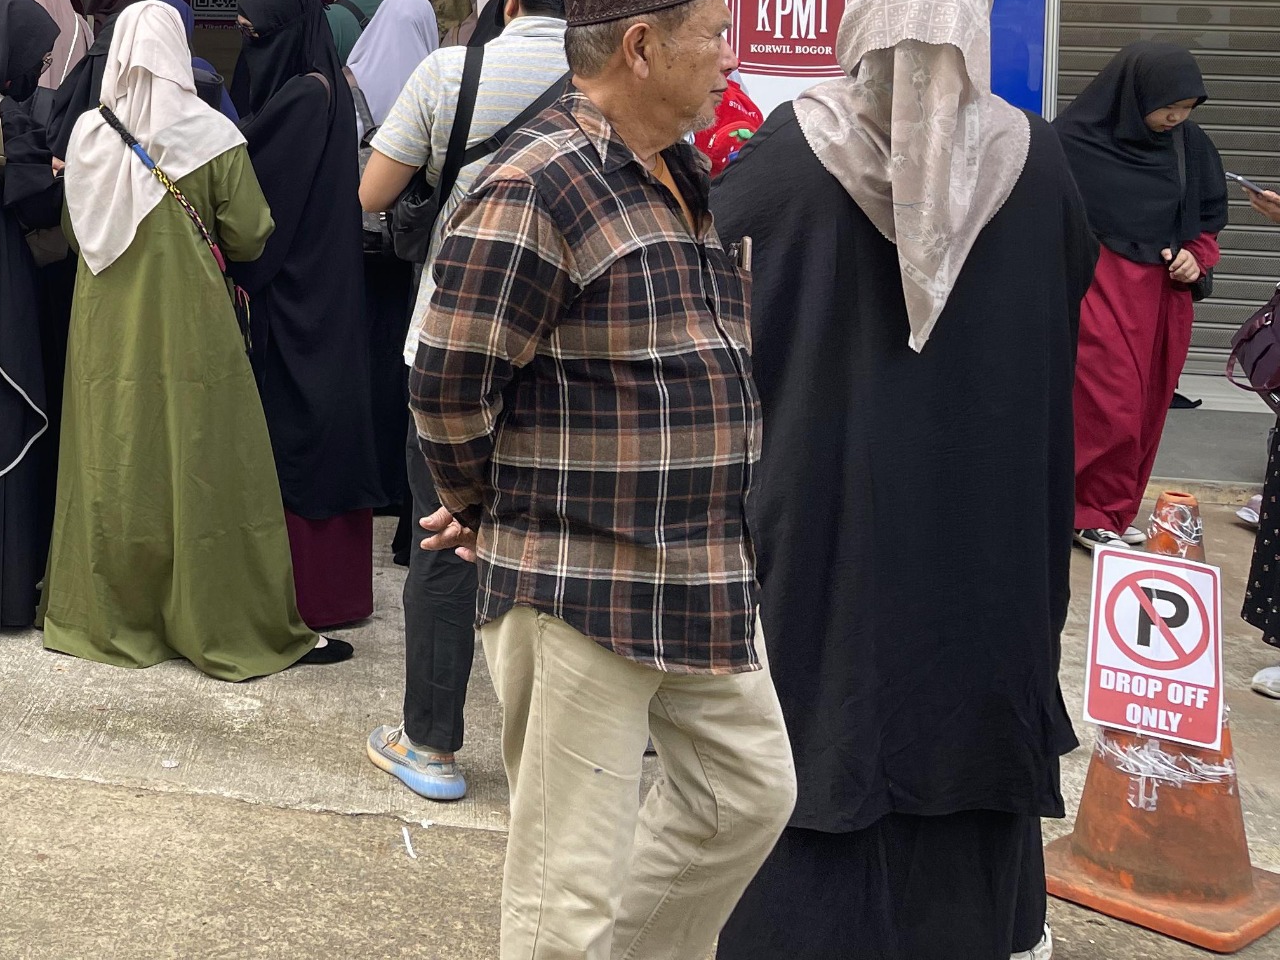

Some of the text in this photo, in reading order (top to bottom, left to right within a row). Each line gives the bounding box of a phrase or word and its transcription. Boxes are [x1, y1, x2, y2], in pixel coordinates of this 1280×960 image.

[750, 43, 833, 55] KORWIL BOGOR
[1099, 668, 1210, 709] DROP OFF
[1126, 702, 1183, 733] ONLY
